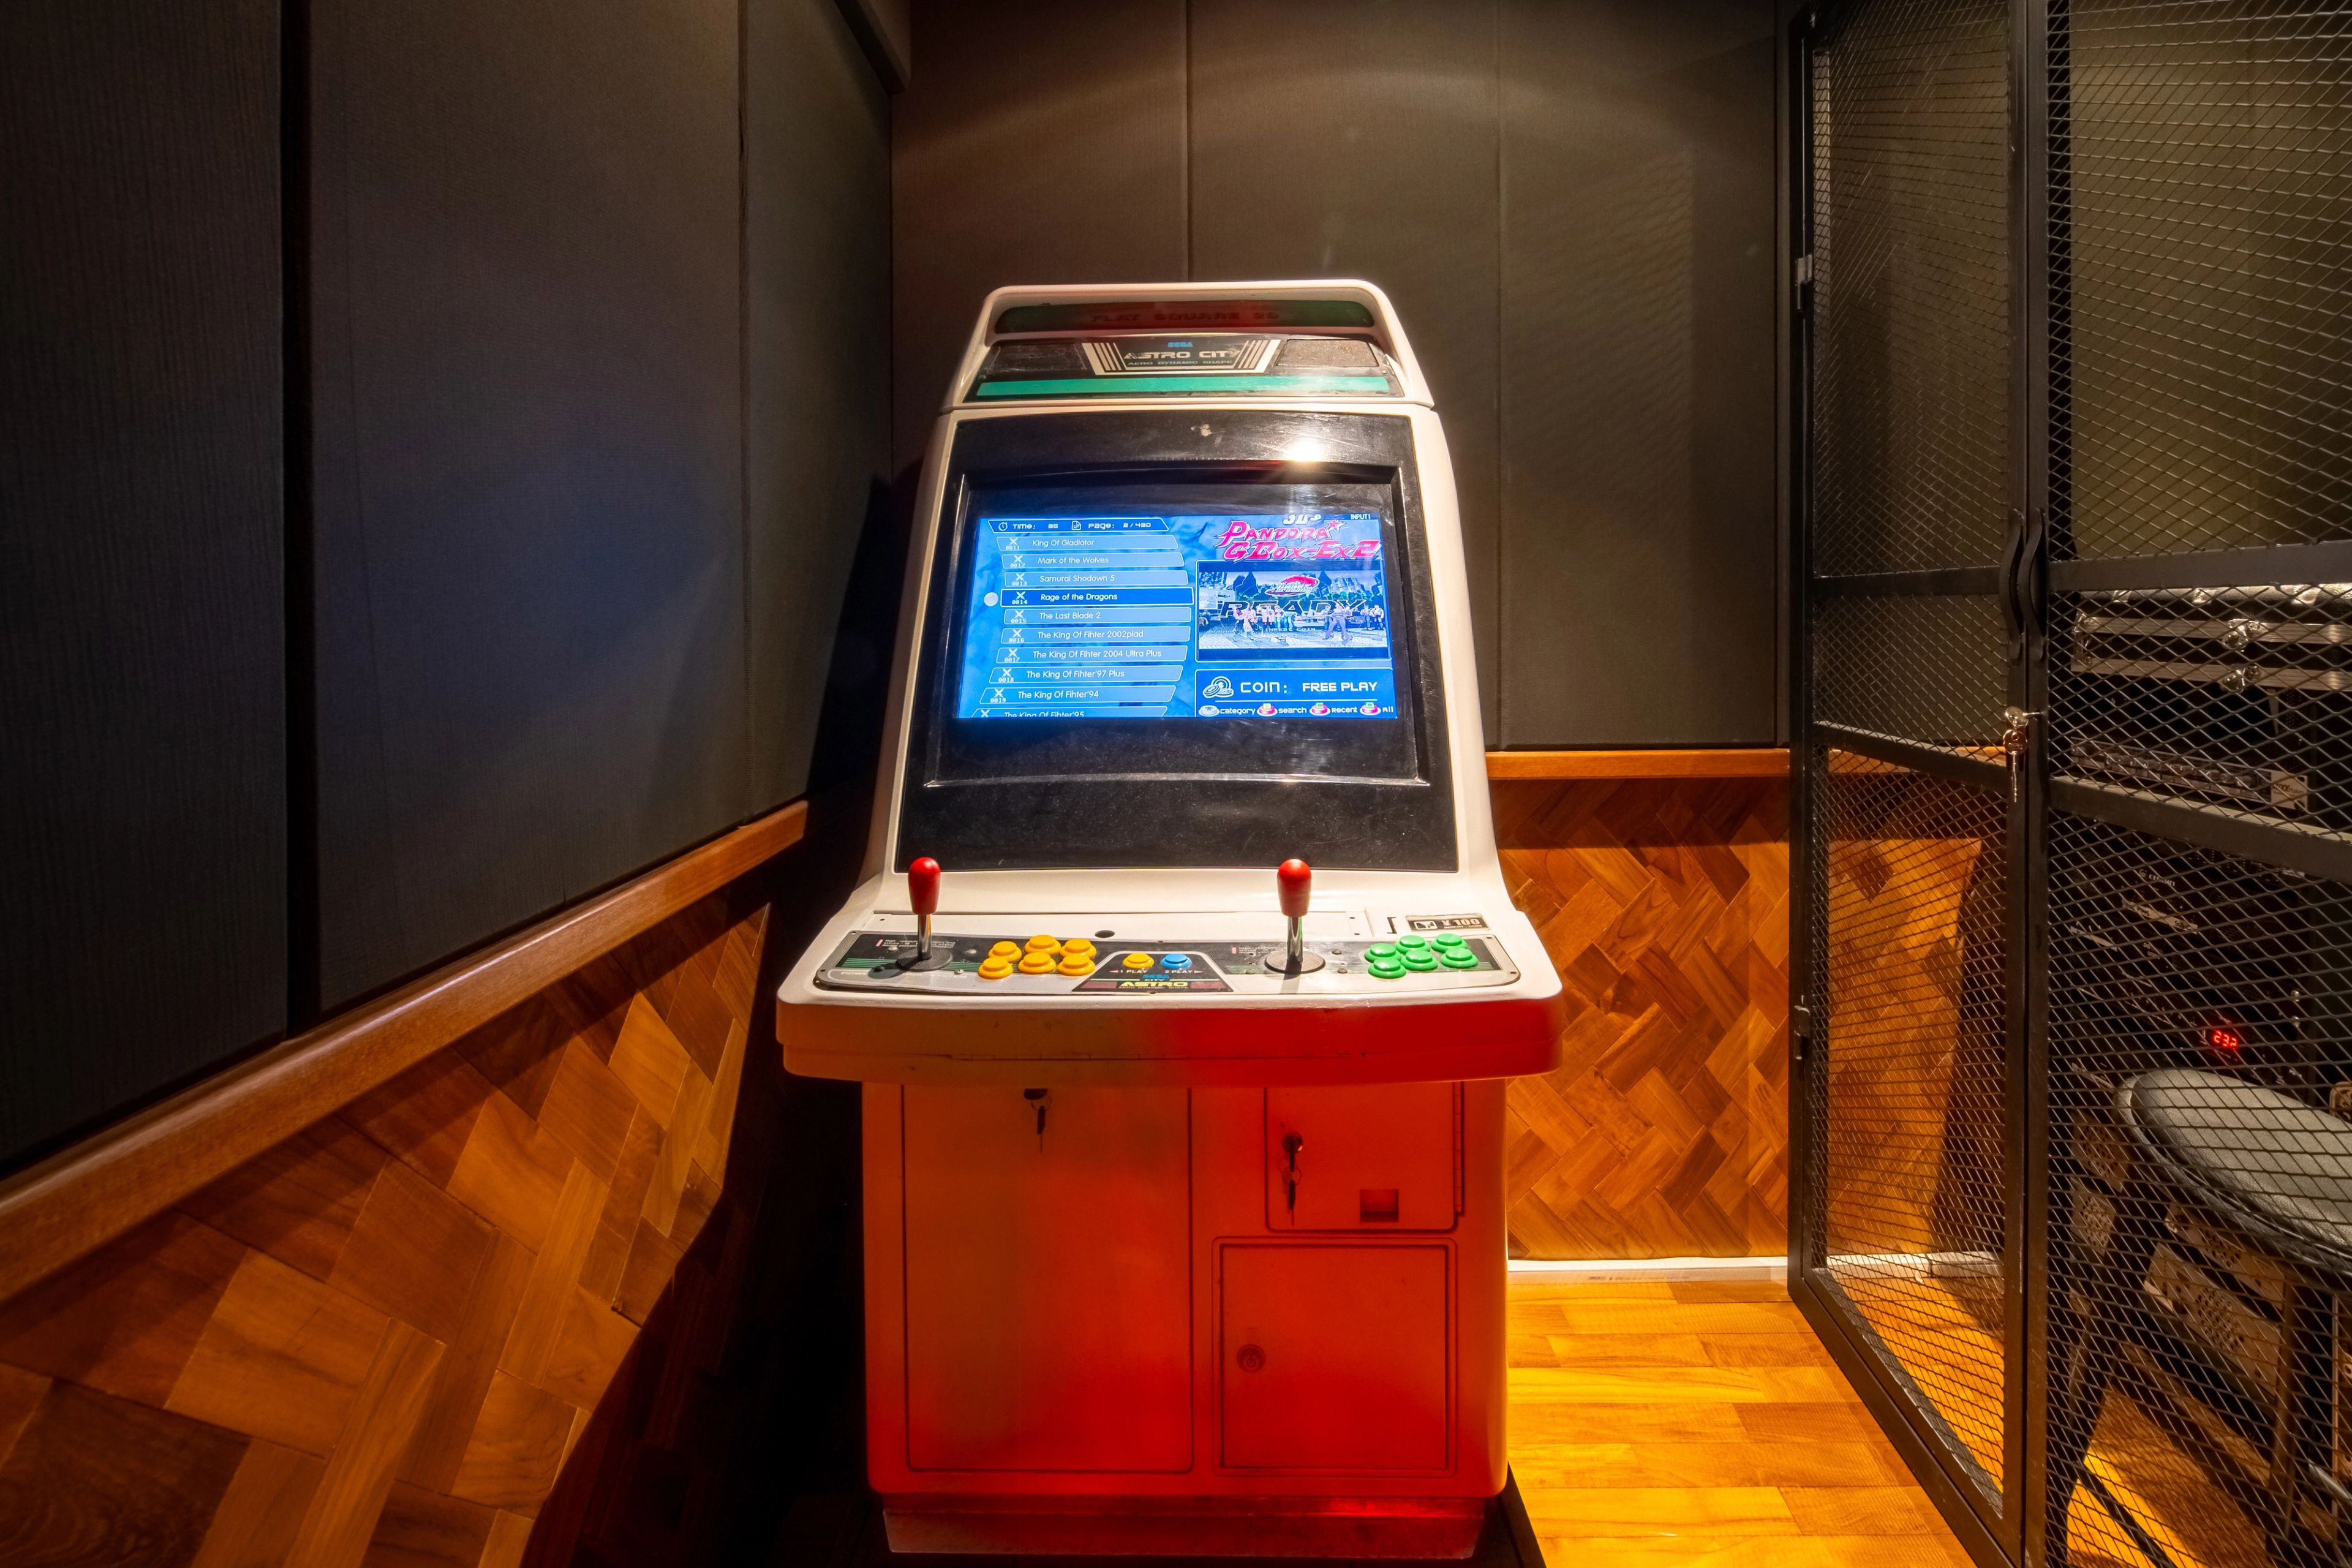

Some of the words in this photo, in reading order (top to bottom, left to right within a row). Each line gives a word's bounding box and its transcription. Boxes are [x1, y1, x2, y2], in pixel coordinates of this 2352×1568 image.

[1153, 312, 1240, 321] SQUARE
[1213, 520, 1332, 548] PANDORA
[1041, 593, 1060, 602] Rage
[1086, 592, 1118, 601] Dragons
[1218, 600, 1368, 618] READY
[1054, 631, 1071, 640] King
[1107, 630, 1144, 639] 2002plad
[1049, 650, 1066, 660] King
[1043, 671, 1060, 680] King
[1302, 682, 1337, 692] FREE
[1341, 682, 1378, 692] PLAY
[1034, 691, 1052, 700] King
